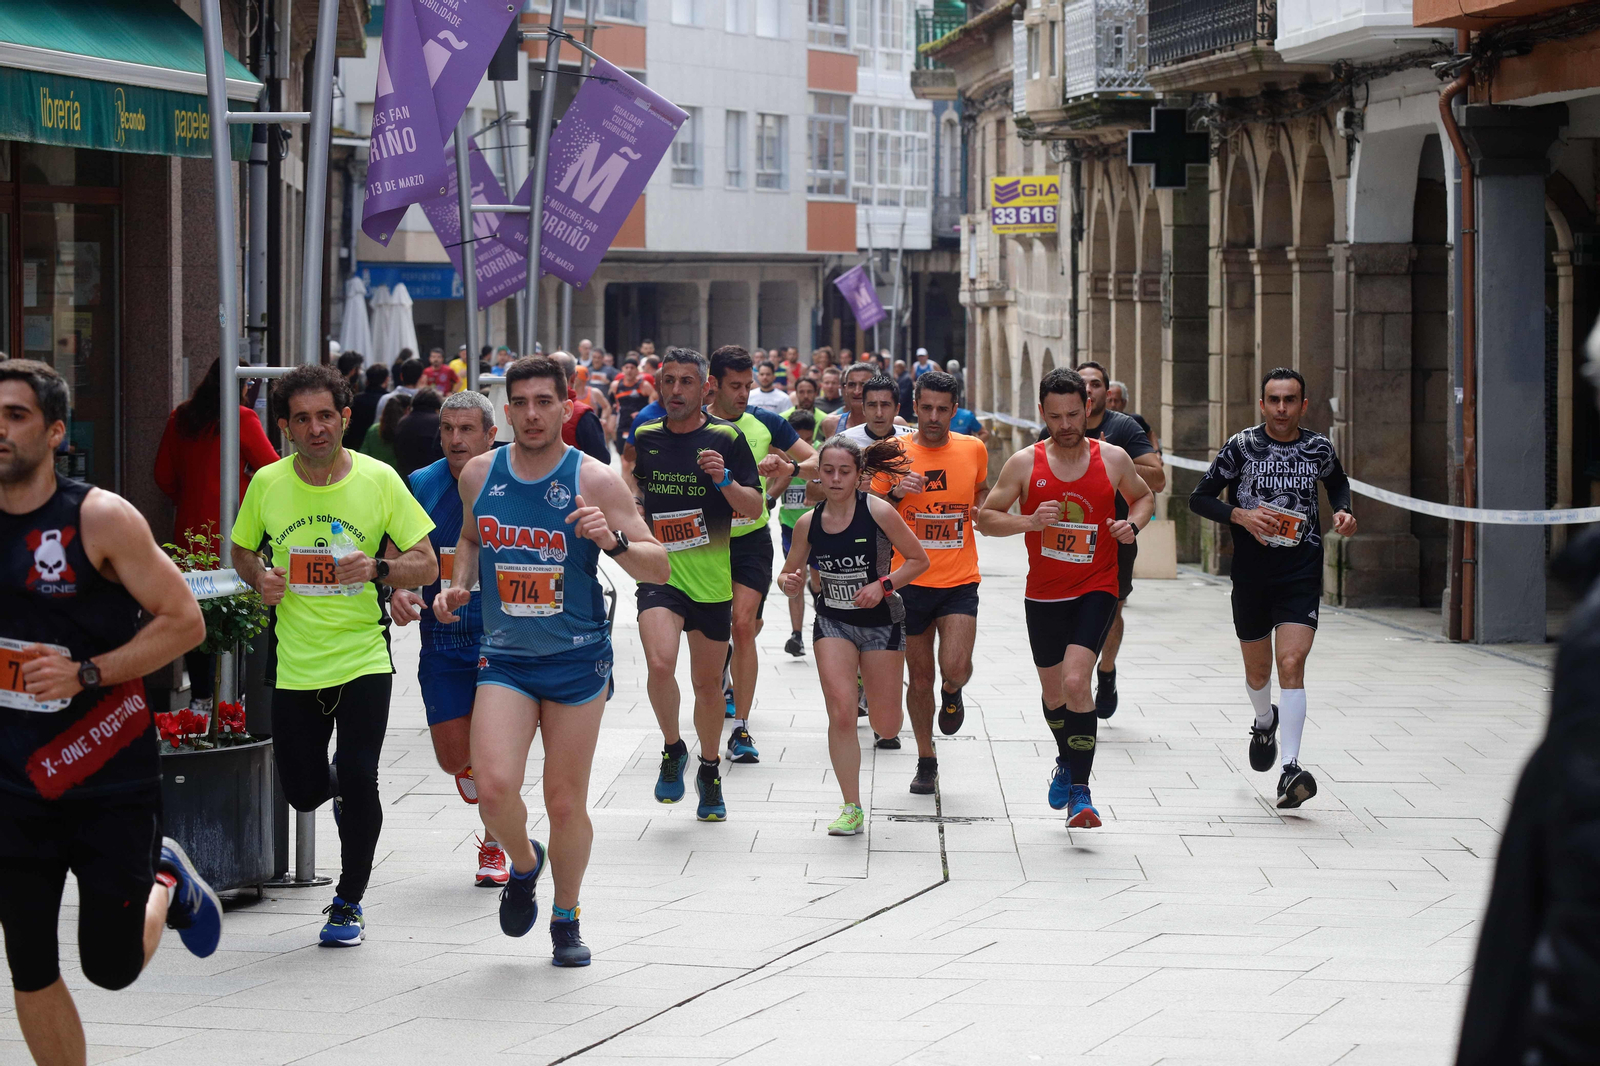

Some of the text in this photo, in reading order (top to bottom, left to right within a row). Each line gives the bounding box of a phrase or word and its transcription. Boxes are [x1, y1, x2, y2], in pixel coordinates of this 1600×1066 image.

[40, 86, 82, 131] librería
[114, 87, 146, 147] Recondo
[388, 105, 410, 122] FAN
[613, 104, 645, 128] IGUALDADE
[601, 118, 638, 146] VISIBILIDADE
[611, 114, 636, 134] CULTURA
[367, 123, 417, 167] RIÑO
[370, 181, 383, 196] 13
[384, 179, 397, 192] DE
[398, 174, 425, 189] MARZO
[1021, 183, 1059, 197] GIA
[549, 198, 585, 224] MULLERES
[583, 219, 599, 234] FAN
[538, 210, 591, 252] ORRIÑO
[514, 232, 524, 242] DO
[547, 251, 555, 261] DE
[554, 256, 575, 272] MARZO
[652, 470, 697, 483] Floristería
[1251, 461, 1319, 475] FORESJANS
[647, 482, 707, 496] CARMEN SIO
[925, 480, 944, 490] AXA
[1257, 476, 1315, 490] RUNNERS
[275, 517, 307, 546] Carreras
[307, 515, 313, 525] y
[661, 522, 694, 542] 1086
[925, 525, 950, 540] 674
[1056, 534, 1076, 552] 92
[306, 562, 336, 584] 153
[509, 580, 539, 603] 714
[827, 583, 857, 600] 1600
[41, 735, 92, 778] X-ONE
